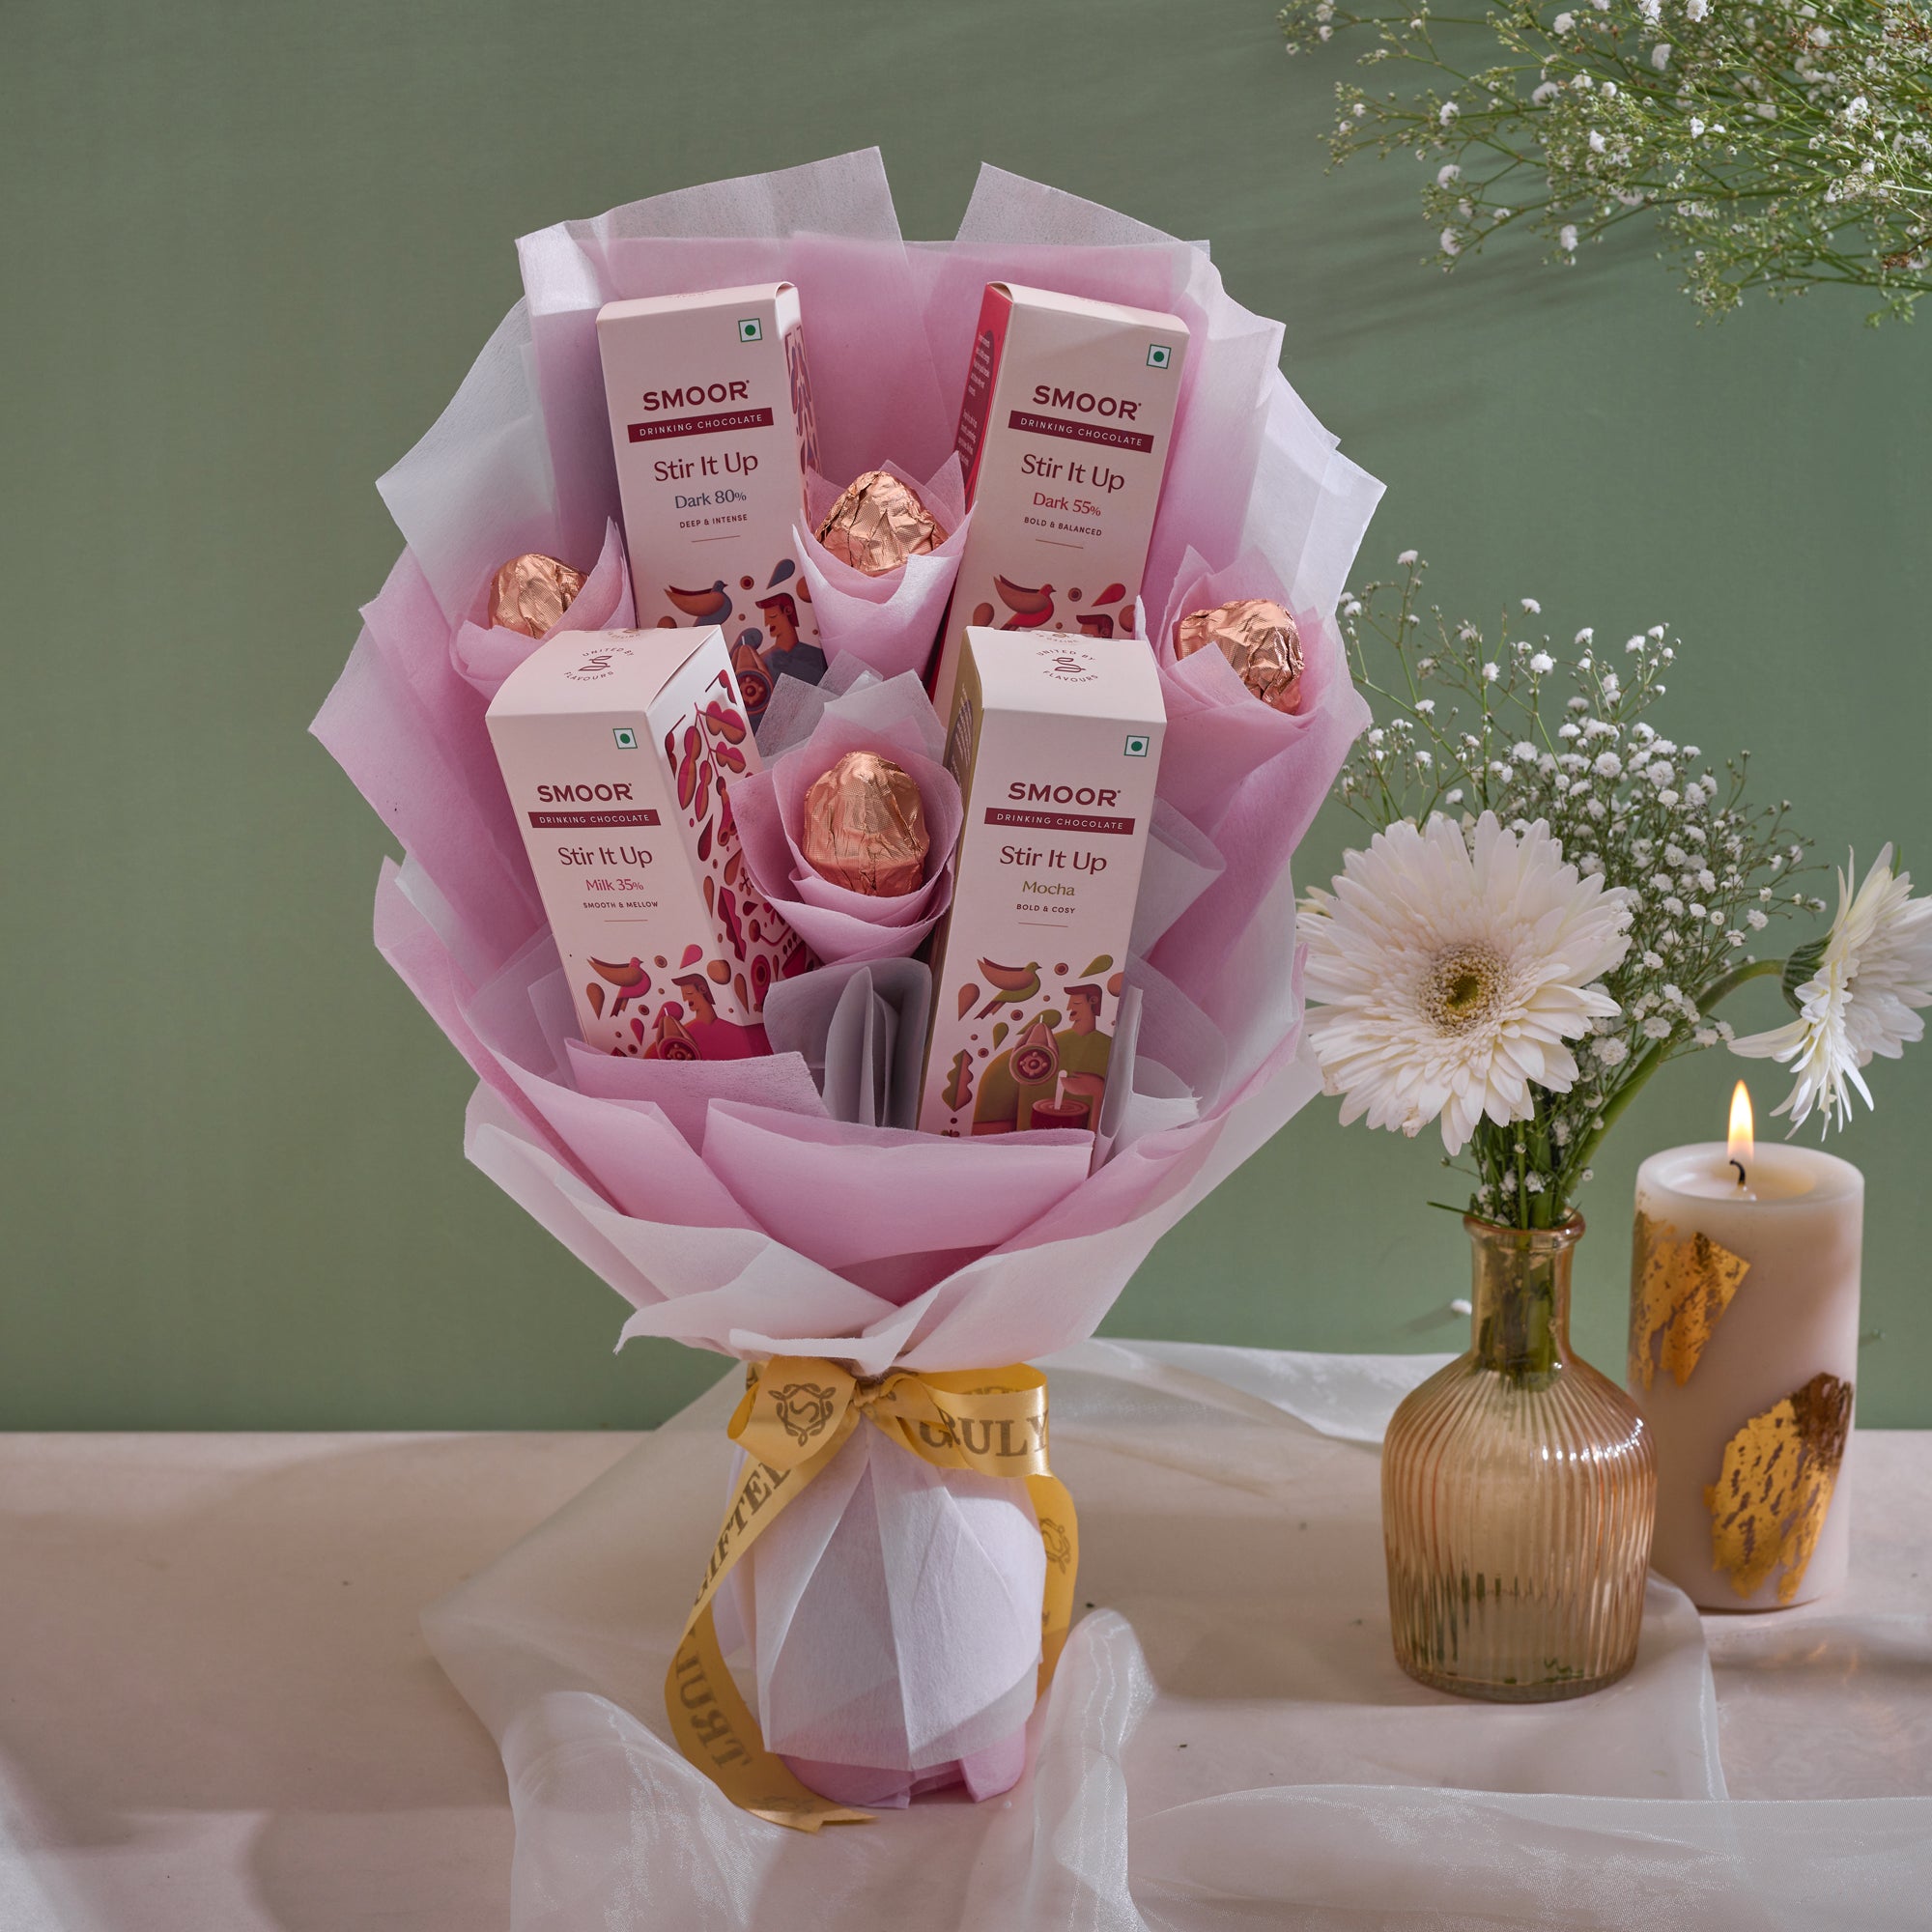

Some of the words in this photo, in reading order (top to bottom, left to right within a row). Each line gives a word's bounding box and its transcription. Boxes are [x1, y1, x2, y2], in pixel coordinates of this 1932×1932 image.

[642, 381, 750, 412] SMOOR
[1032, 384, 1141, 421] SMOOR
[639, 422, 693, 437] DRINKING
[696, 413, 763, 430] CHOCOLATE
[1020, 417, 1073, 434] DRINKING
[1078, 428, 1143, 446] CHOCOLATE
[654, 458, 696, 482] Stir
[700, 456, 718, 476] It
[724, 452, 759, 476] Up
[1021, 453, 1063, 479] Stir
[1067, 462, 1087, 483] It
[1092, 466, 1124, 494] Up
[674, 491, 712, 509] Dark
[715, 489, 747, 504] 80%
[1033, 492, 1068, 510] Dark
[1072, 498, 1101, 517] 55%
[679, 519, 702, 528] DEEP
[712, 514, 748, 526] INTENSE
[1024, 516, 1047, 527] BOLD
[1058, 523, 1102, 536] BALANCED
[1043, 669, 1098, 682] FLAVOURS
[537, 782, 634, 803] SMOOR
[1008, 781, 1121, 808] SMOOR
[589, 814, 650, 823] CHOCOLATE
[997, 813, 1051, 825] DRINKING
[1056, 818, 1123, 830] CHOCOLATE
[557, 846, 594, 866] Stir
[599, 846, 617, 866] It
[619, 846, 653, 868] Up
[999, 845, 1043, 867] Stir
[1048, 849, 1067, 868] It
[1072, 851, 1107, 875] Up
[585, 879, 615, 892] Milk
[615, 878, 644, 891] 35%
[1022, 880, 1075, 896] Mocha
[1016, 903, 1040, 912] BOLD
